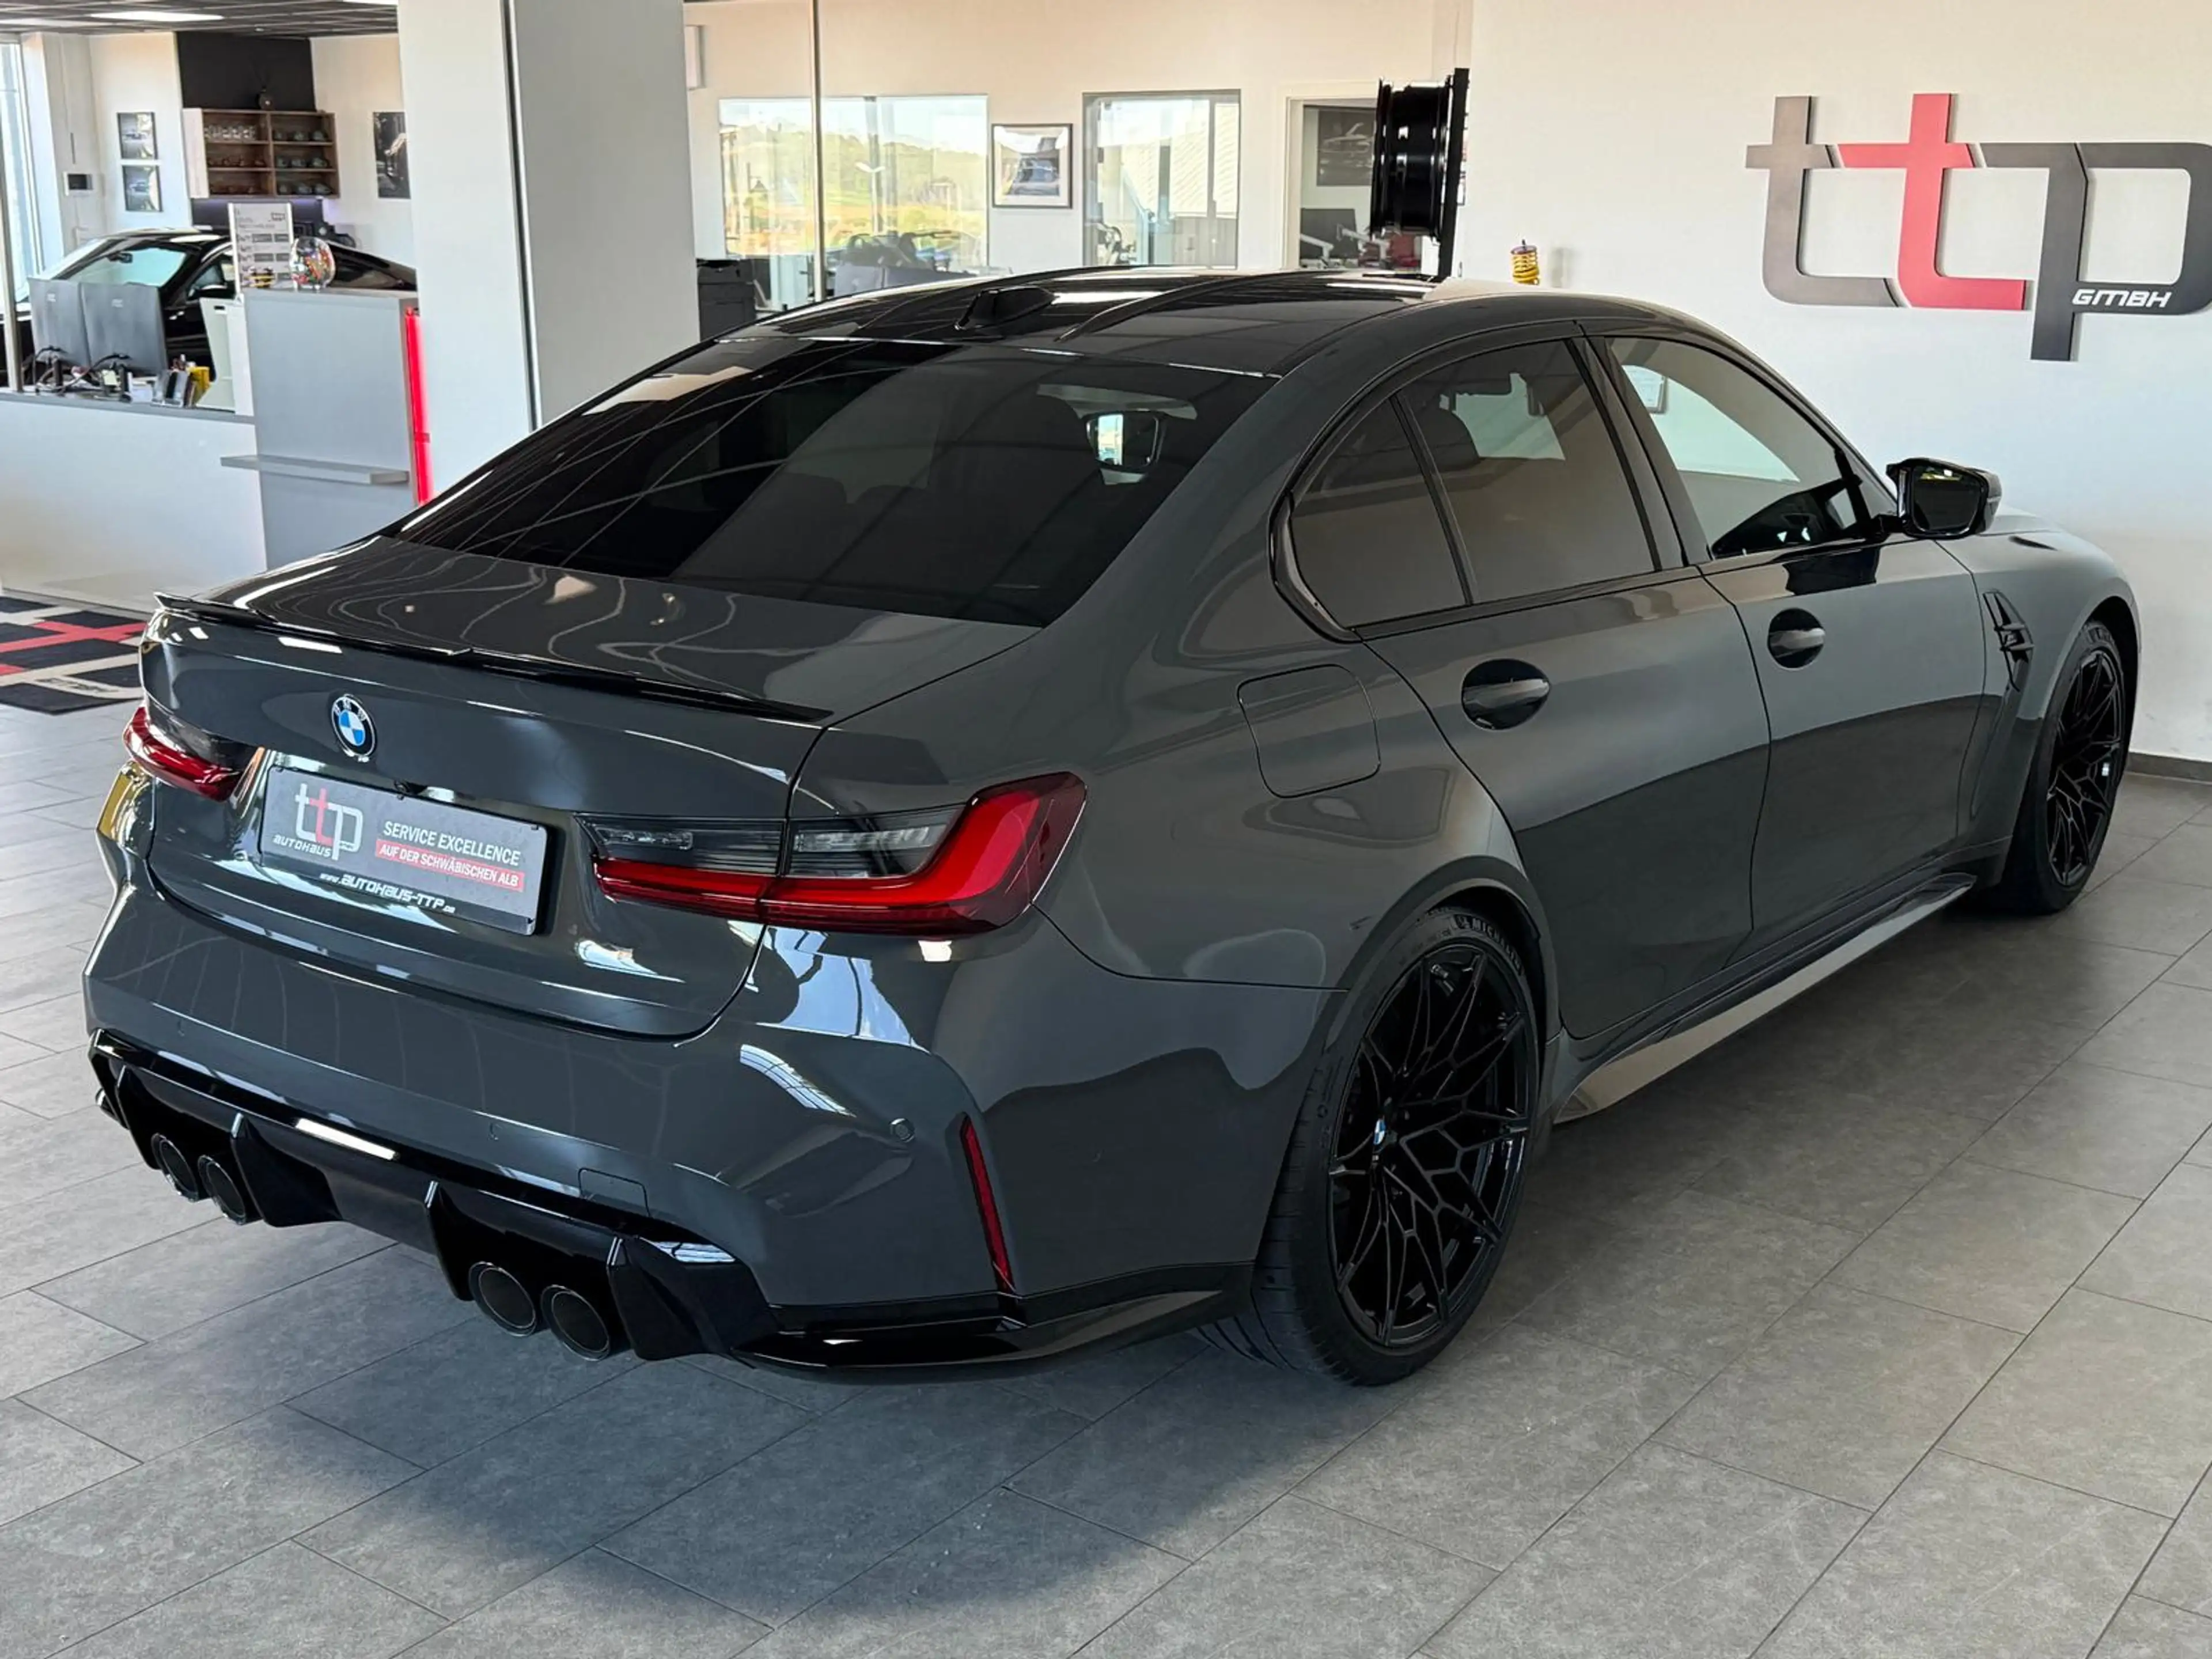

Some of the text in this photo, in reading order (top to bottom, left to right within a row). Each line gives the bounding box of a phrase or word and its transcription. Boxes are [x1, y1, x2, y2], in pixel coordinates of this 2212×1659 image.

[383, 820, 521, 866] SERVICE EXCELLENCE
[378, 844, 520, 887] AUF DER SCHWÄBISCHEN ALB
